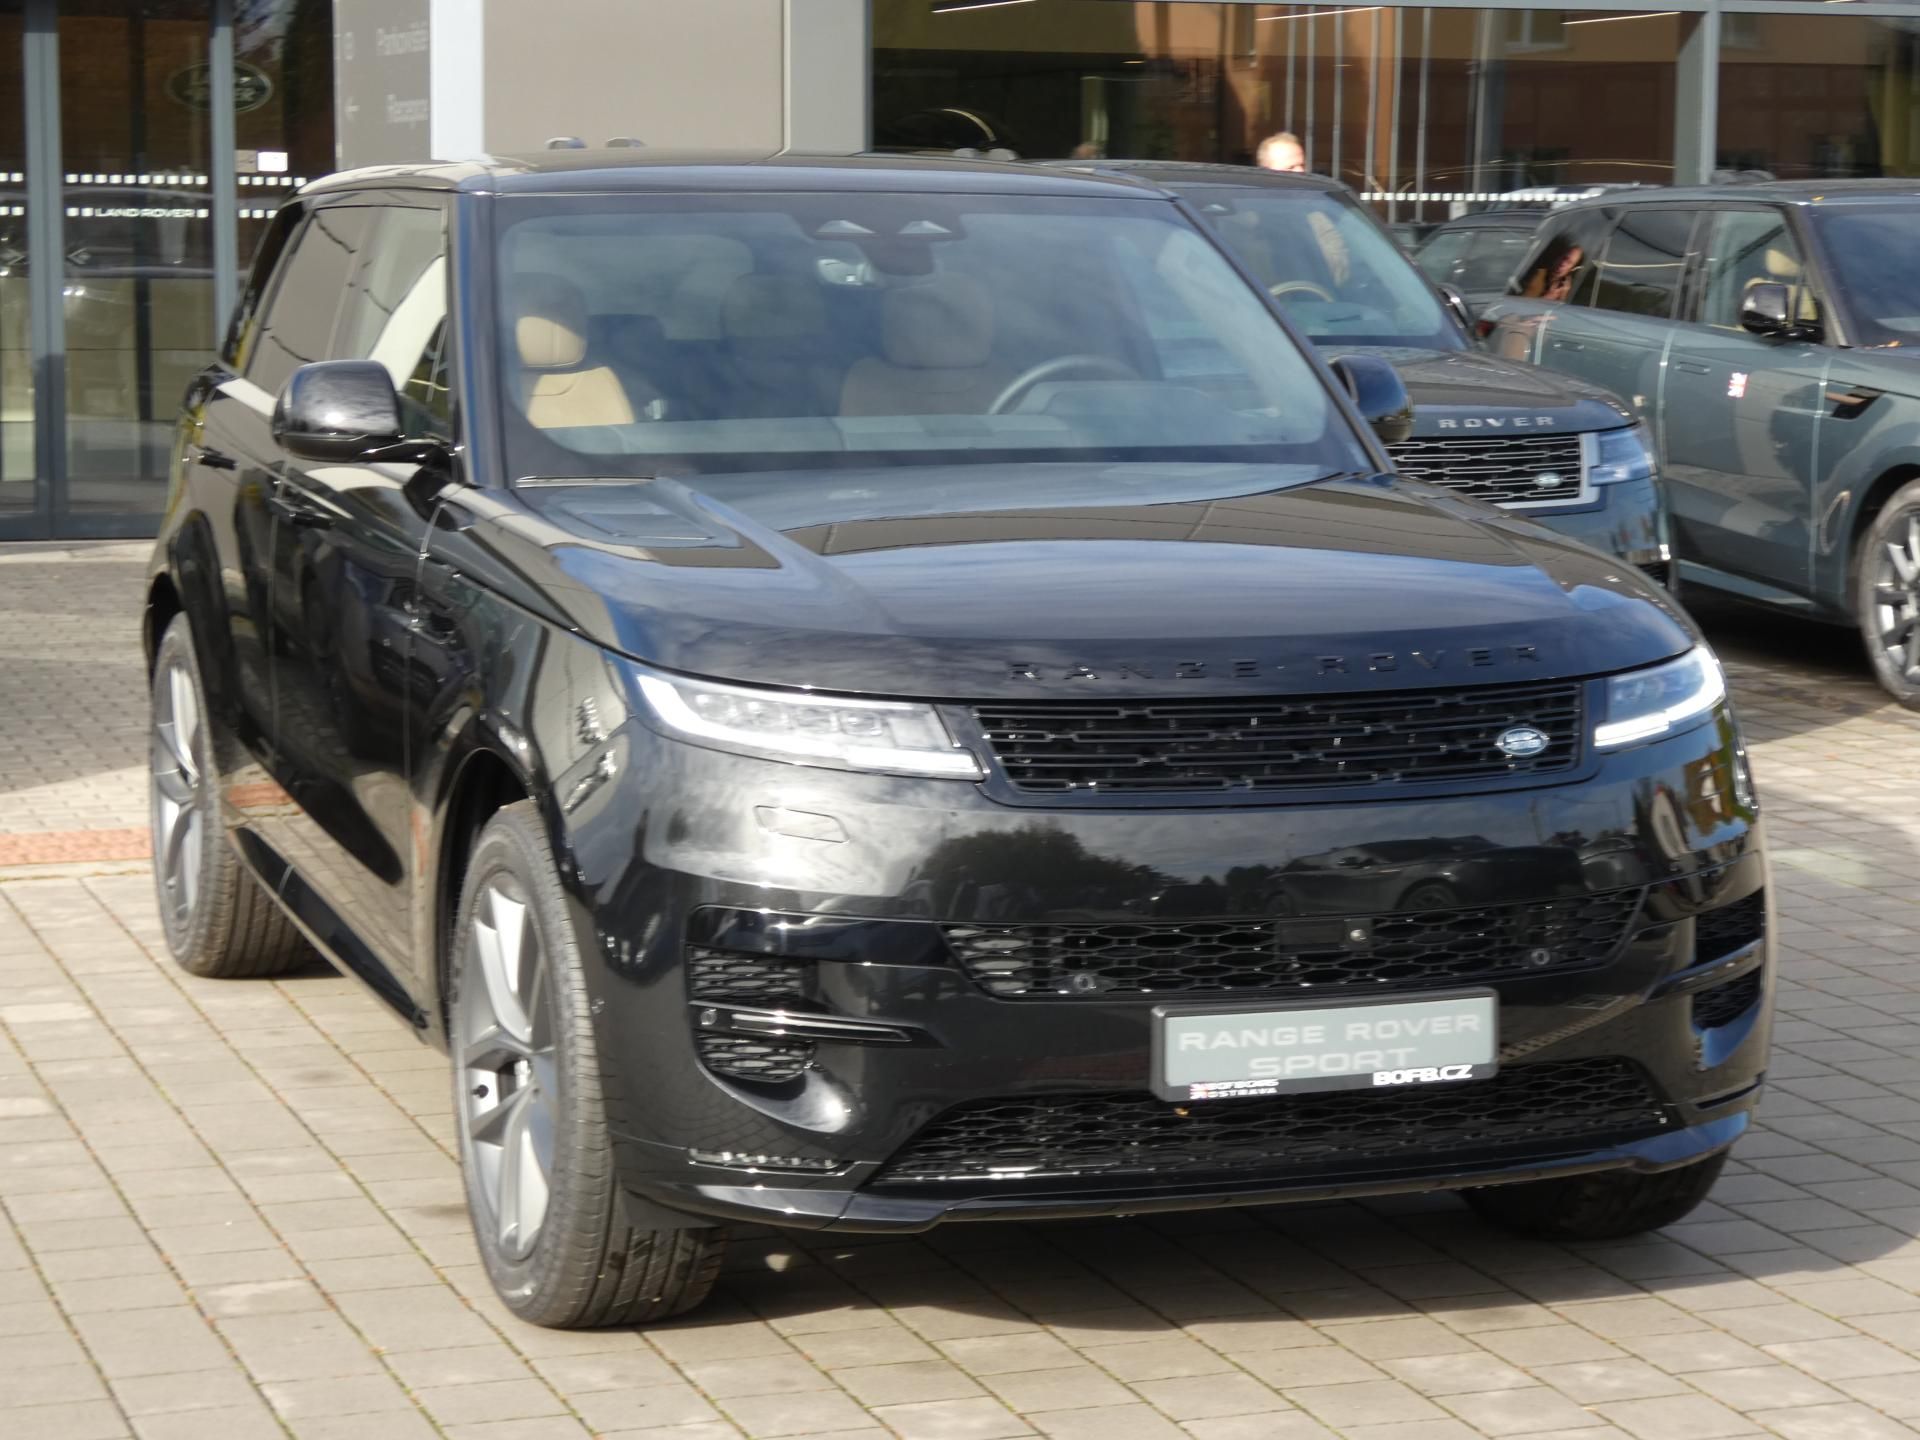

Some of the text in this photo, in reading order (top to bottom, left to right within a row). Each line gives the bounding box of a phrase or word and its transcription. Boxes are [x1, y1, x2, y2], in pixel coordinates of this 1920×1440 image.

[94, 207, 196, 219] LAND ROVER
[1437, 416, 1555, 429] ROVER
[1006, 645, 1540, 681] RANGE ROVER
[1178, 1015, 1480, 1051] RANGE ROVER
[1250, 1048, 1417, 1077] SPORT
